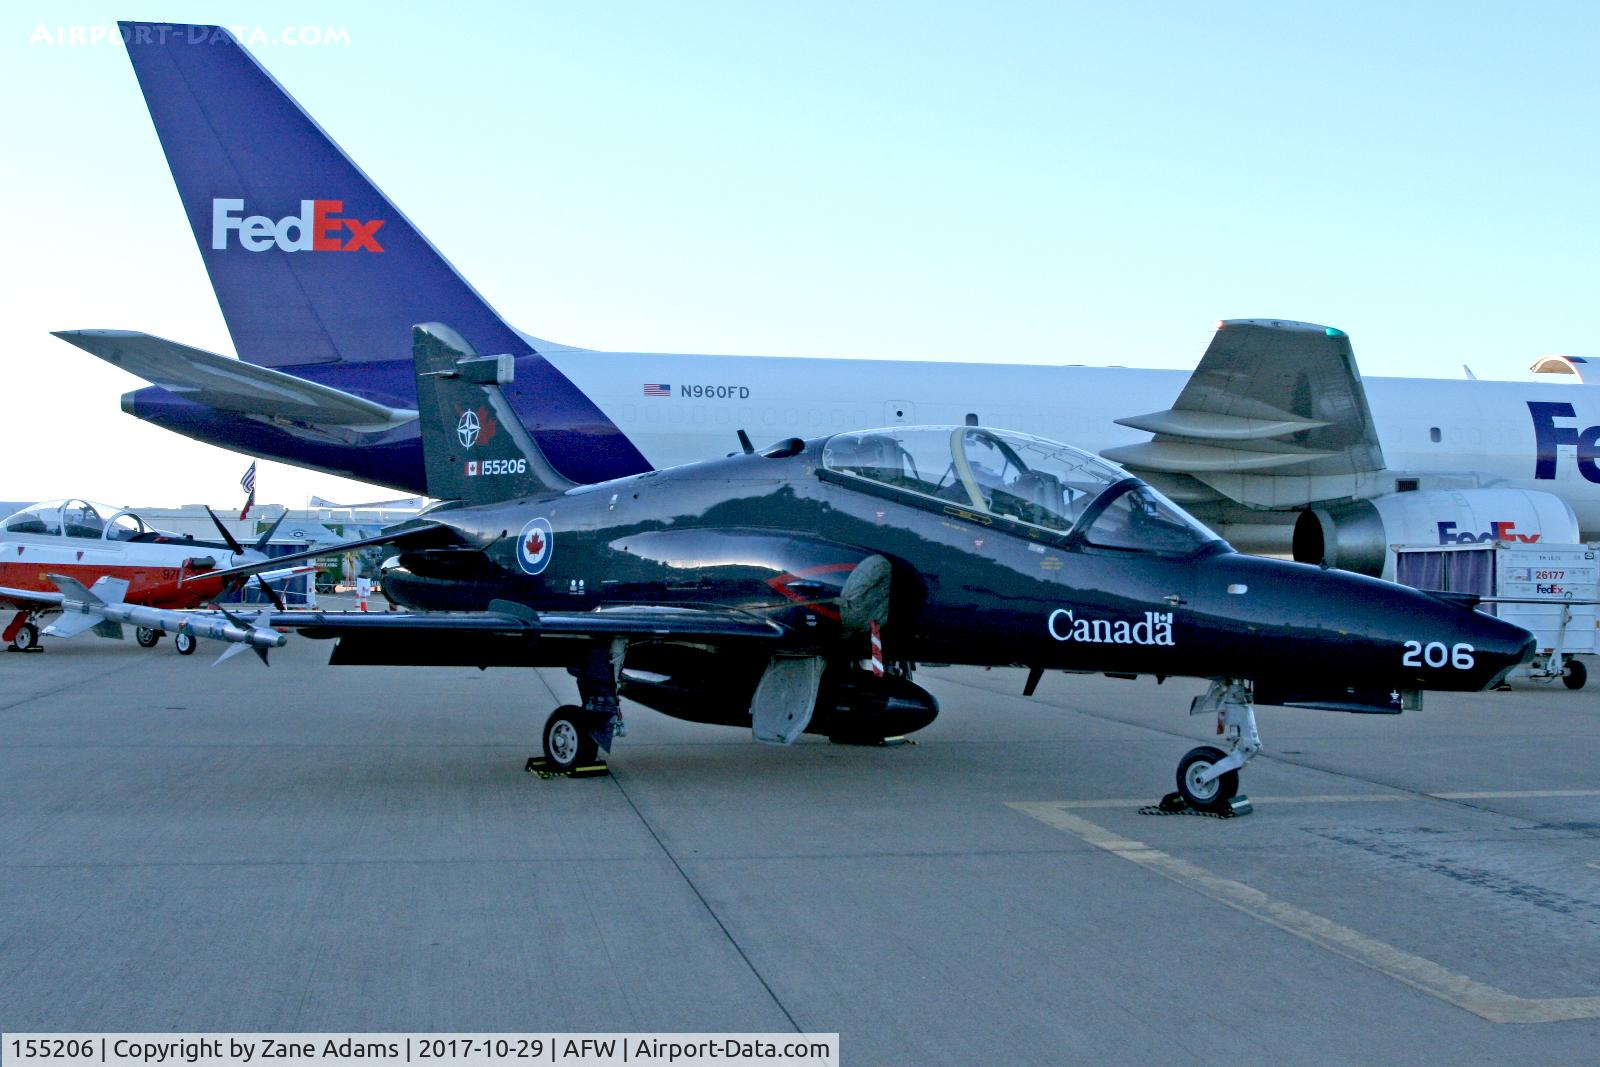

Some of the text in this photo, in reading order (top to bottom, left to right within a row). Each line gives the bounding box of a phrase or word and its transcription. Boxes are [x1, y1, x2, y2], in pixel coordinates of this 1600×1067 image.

[212, 198, 385, 253] FedEx
[681, 384, 749, 399] N960FD
[482, 459, 526, 475] 155206
[1535, 570, 1565, 580] 26177
[1536, 583, 1564, 594] FedEx
[1049, 608, 1176, 646] Canada
[1403, 640, 1475, 670] 206
